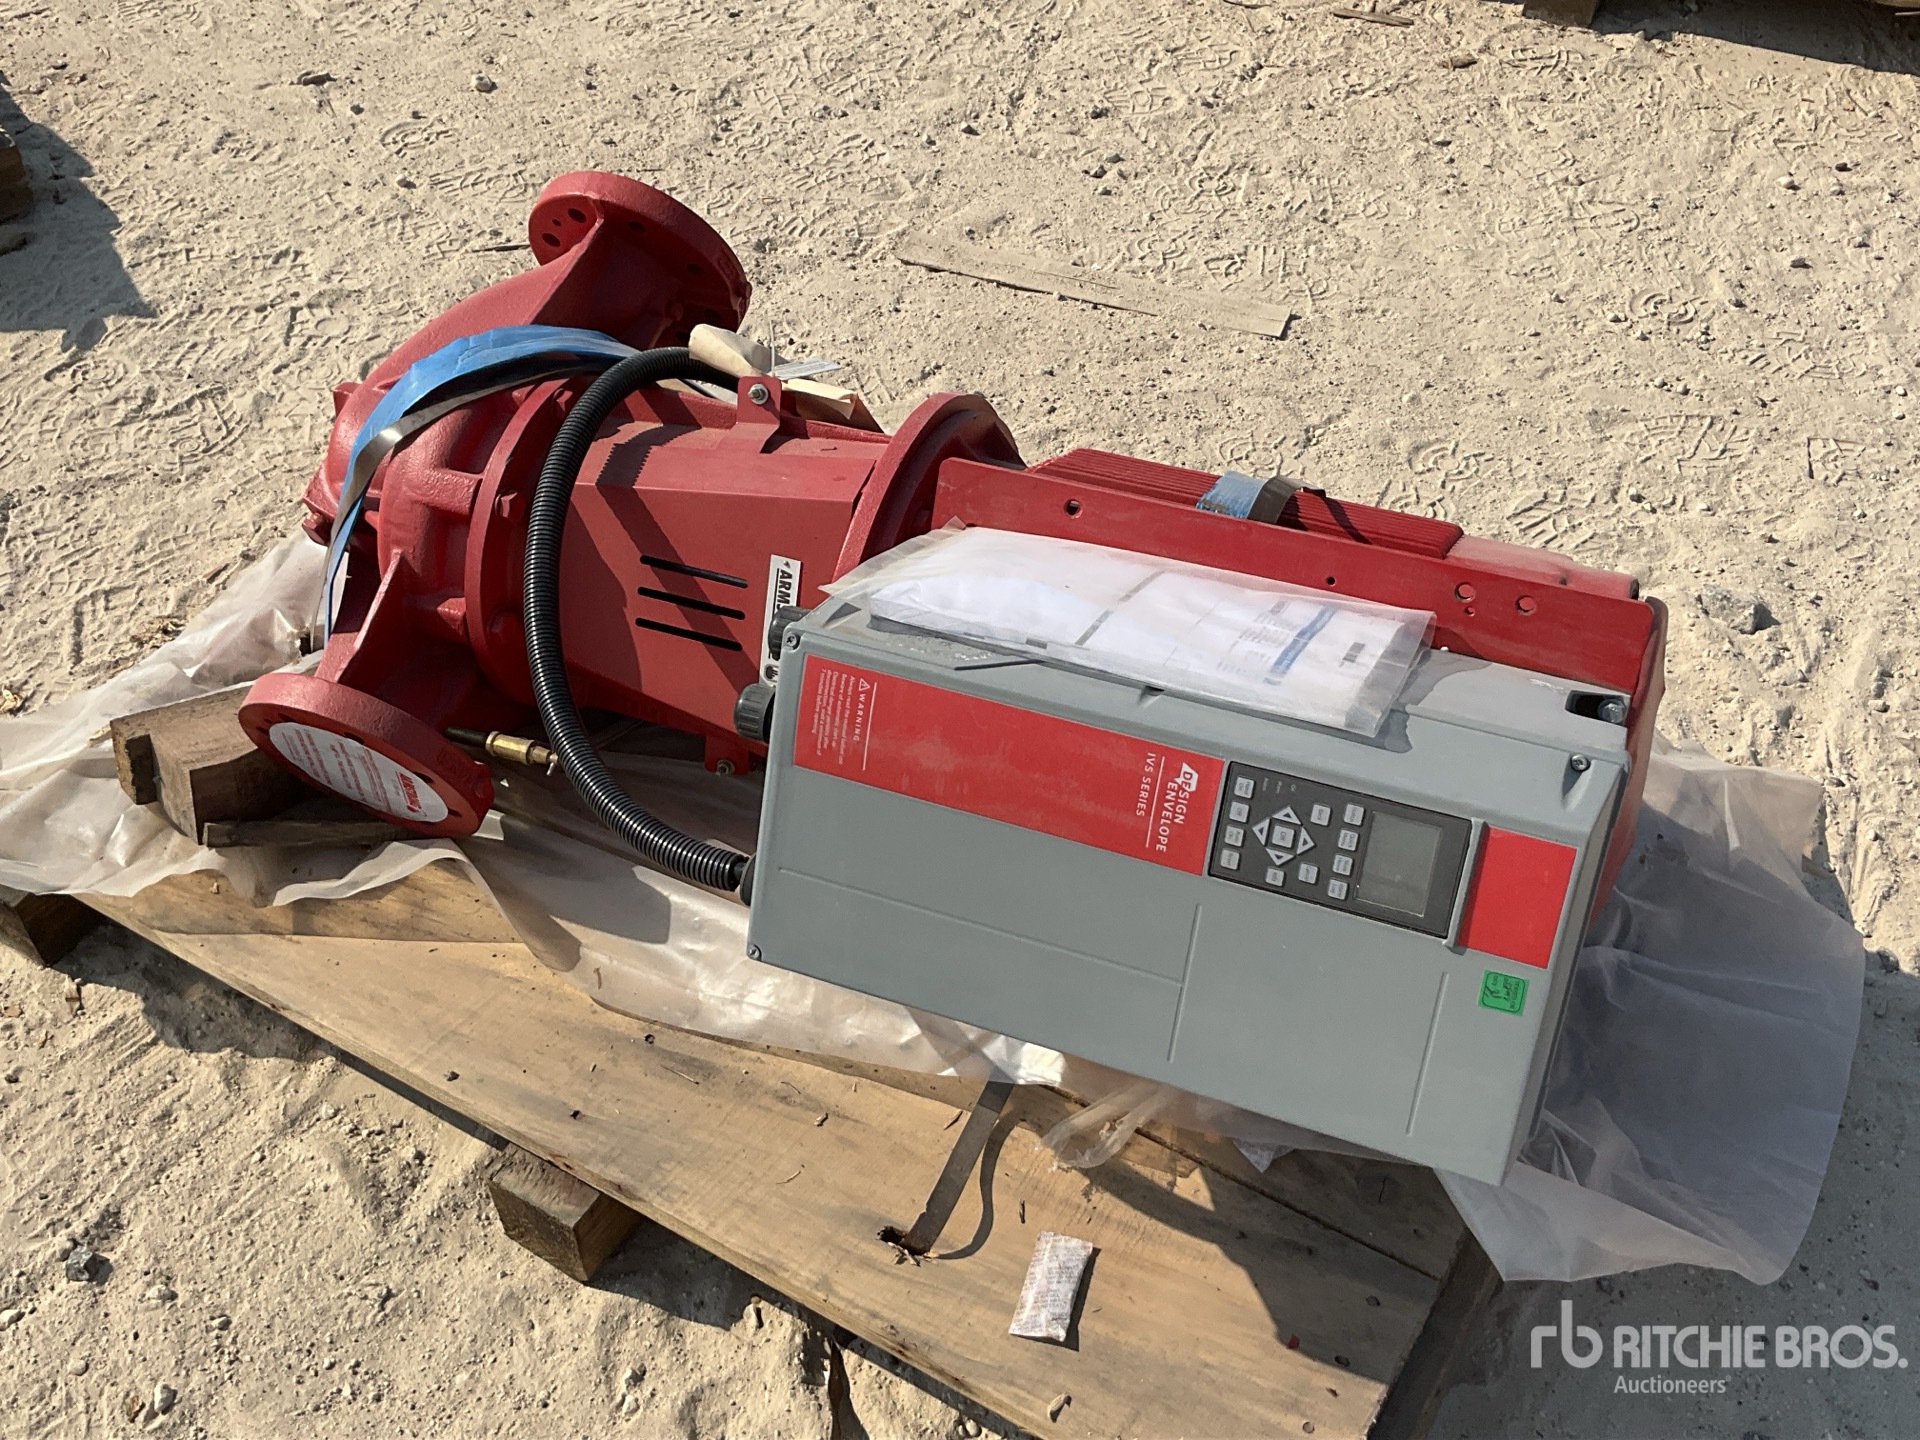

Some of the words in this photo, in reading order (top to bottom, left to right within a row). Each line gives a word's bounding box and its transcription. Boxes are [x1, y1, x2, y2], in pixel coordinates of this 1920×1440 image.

[775, 569, 793, 611] ARM
[817, 672, 825, 694] minutes
[829, 671, 838, 695] Electrical
[847, 675, 855, 695] Always
[826, 696, 834, 714] danger
[834, 700, 842, 726] automatic
[853, 692, 865, 741] WARNING
[841, 718, 849, 737] manual
[1144, 752, 1155, 772] IVS
[1135, 776, 1151, 816] SERIES
[1173, 770, 1193, 824] DESIGN
[1155, 781, 1178, 852] ENVELOPE
[1279, 831, 1286, 841] OK
